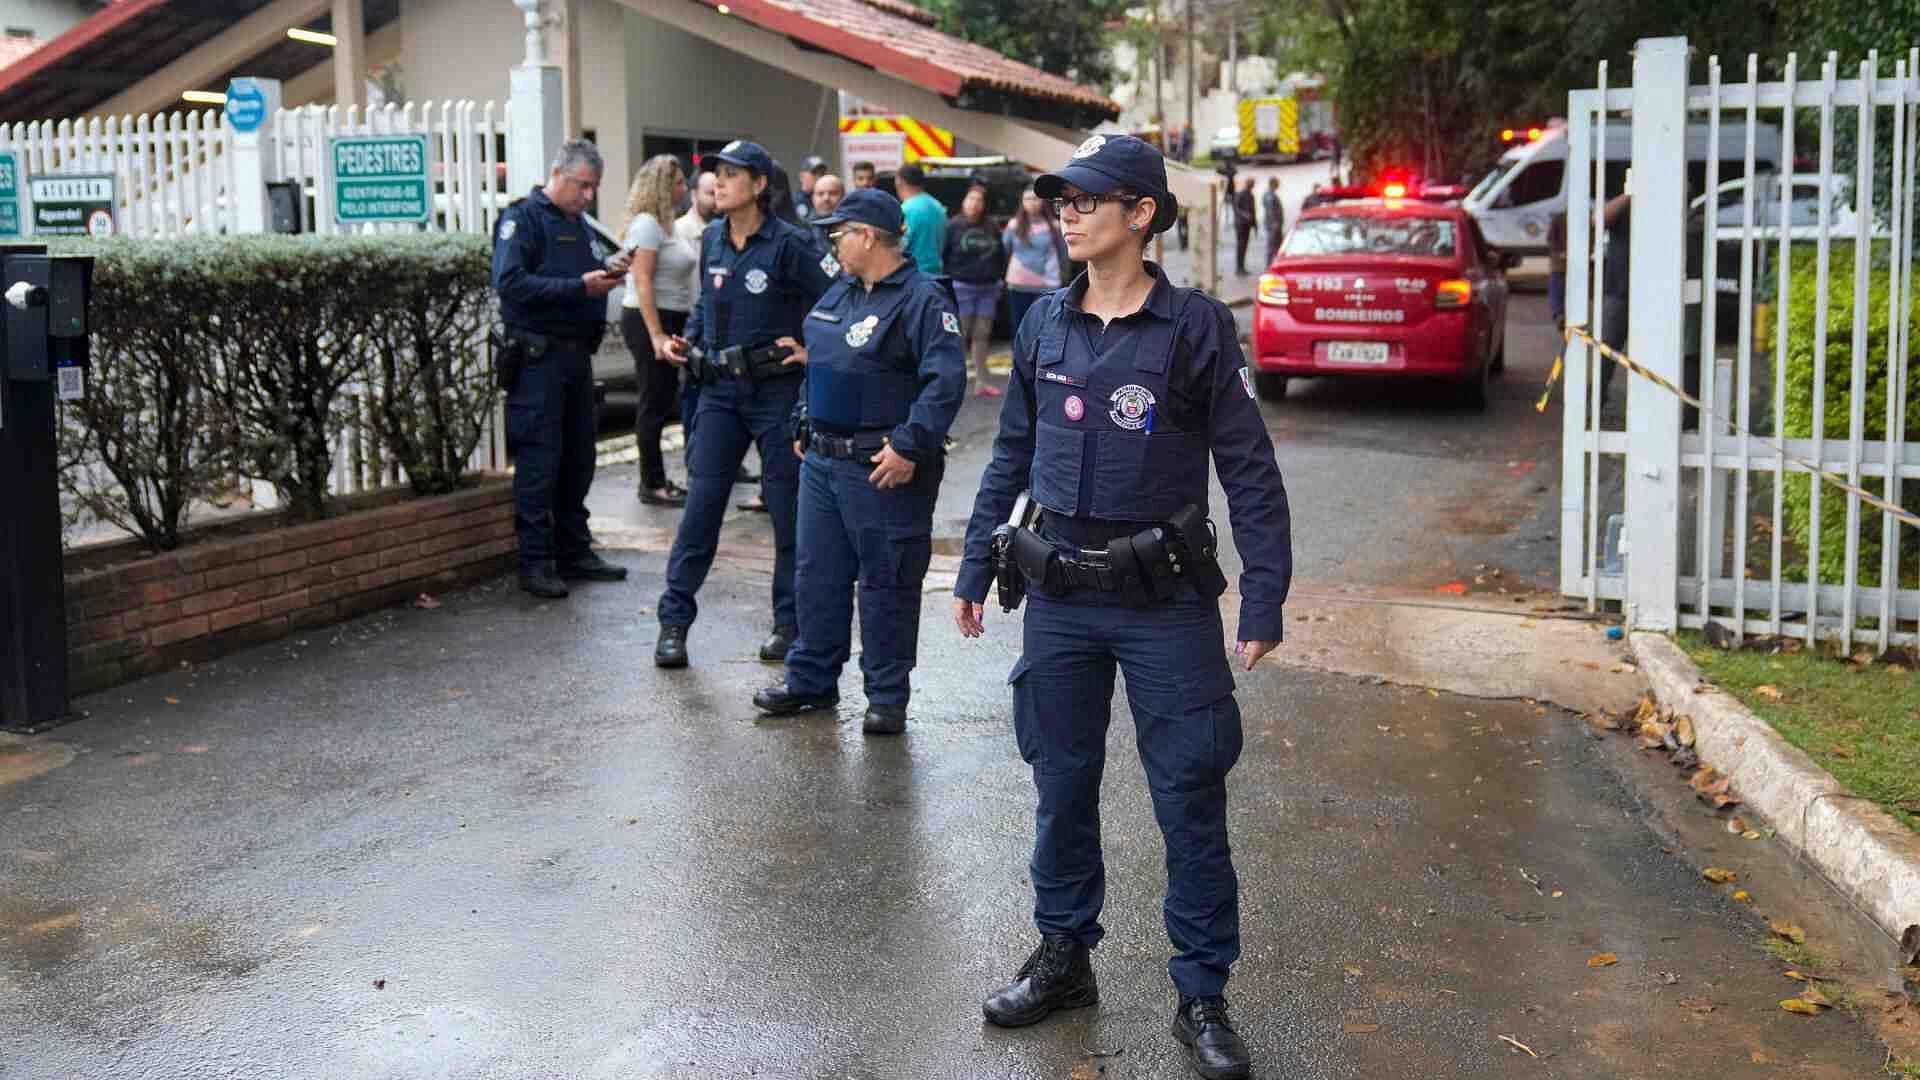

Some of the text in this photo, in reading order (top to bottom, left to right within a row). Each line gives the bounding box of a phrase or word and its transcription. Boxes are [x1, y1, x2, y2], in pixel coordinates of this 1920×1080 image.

[337, 142, 420, 173] PEDESTRES
[343, 185, 419, 199] IDENTIFIQUE-SE
[340, 200, 421, 215] PELO INTERFONE
[1315, 277, 1343, 291] 193
[1314, 307, 1405, 322] BOMBEIROS
